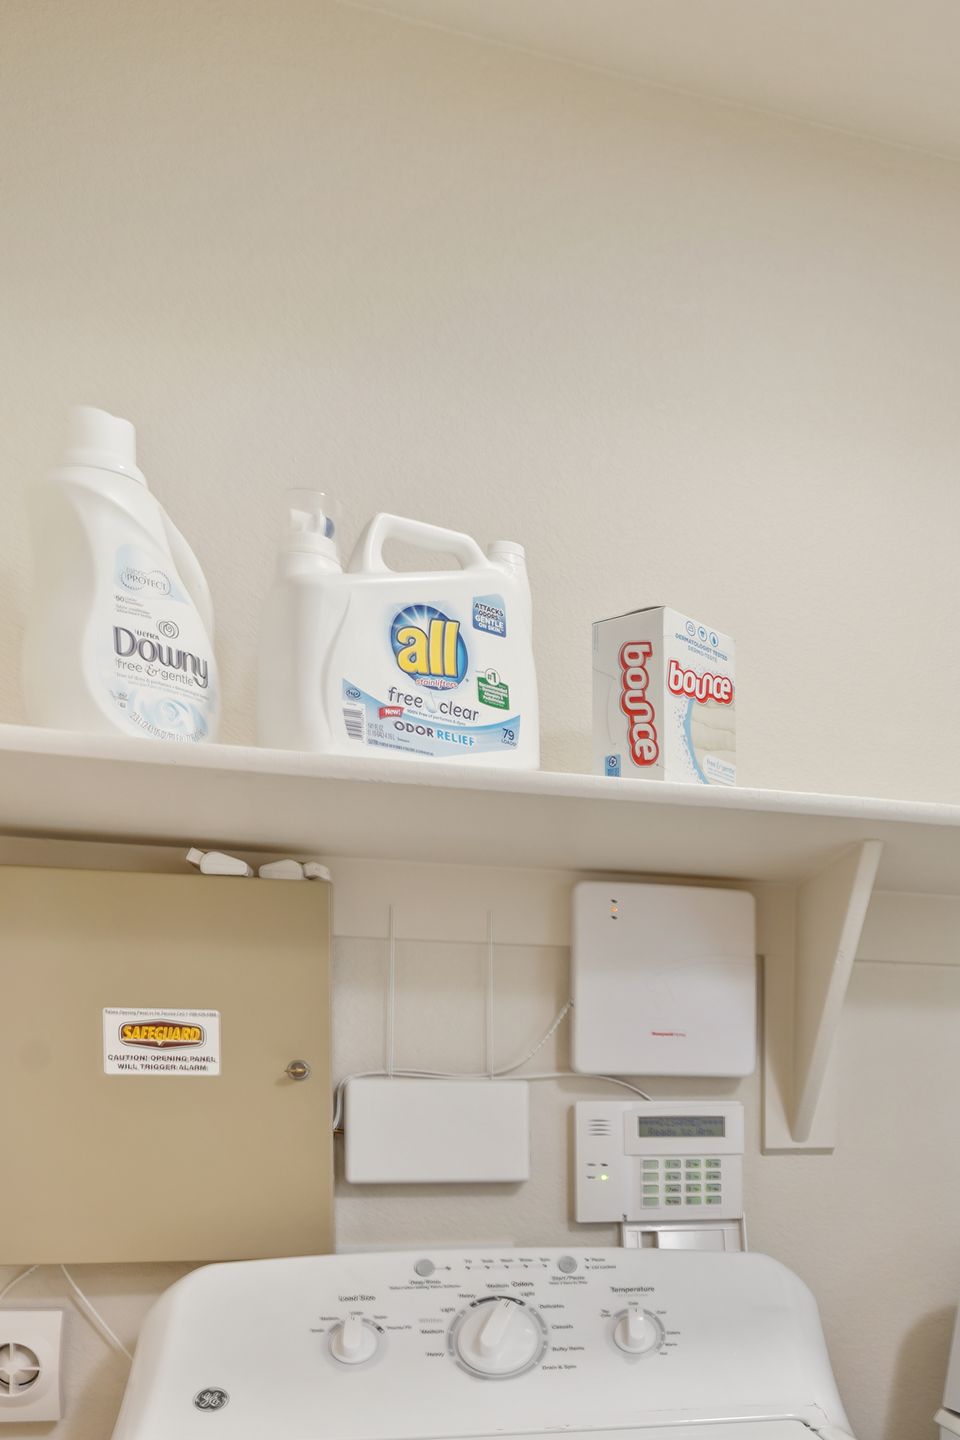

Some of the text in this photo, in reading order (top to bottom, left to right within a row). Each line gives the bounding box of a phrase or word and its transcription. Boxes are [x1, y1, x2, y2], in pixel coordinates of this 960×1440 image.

[475, 603, 503, 617] ATTACKS
[113, 626, 208, 689] Downy
[397, 619, 459, 678] all
[116, 658, 143, 673] free
[161, 669, 194, 687] gentle
[487, 672, 497, 683] #1
[668, 660, 733, 704] bounce
[388, 687, 479, 722] free clear
[619, 641, 659, 767] bounce
[394, 720, 434, 738] ODOR
[436, 729, 475, 747] RELIEF
[502, 728, 515, 741] 79
[122, 1025, 201, 1041] SAFEGUARD
